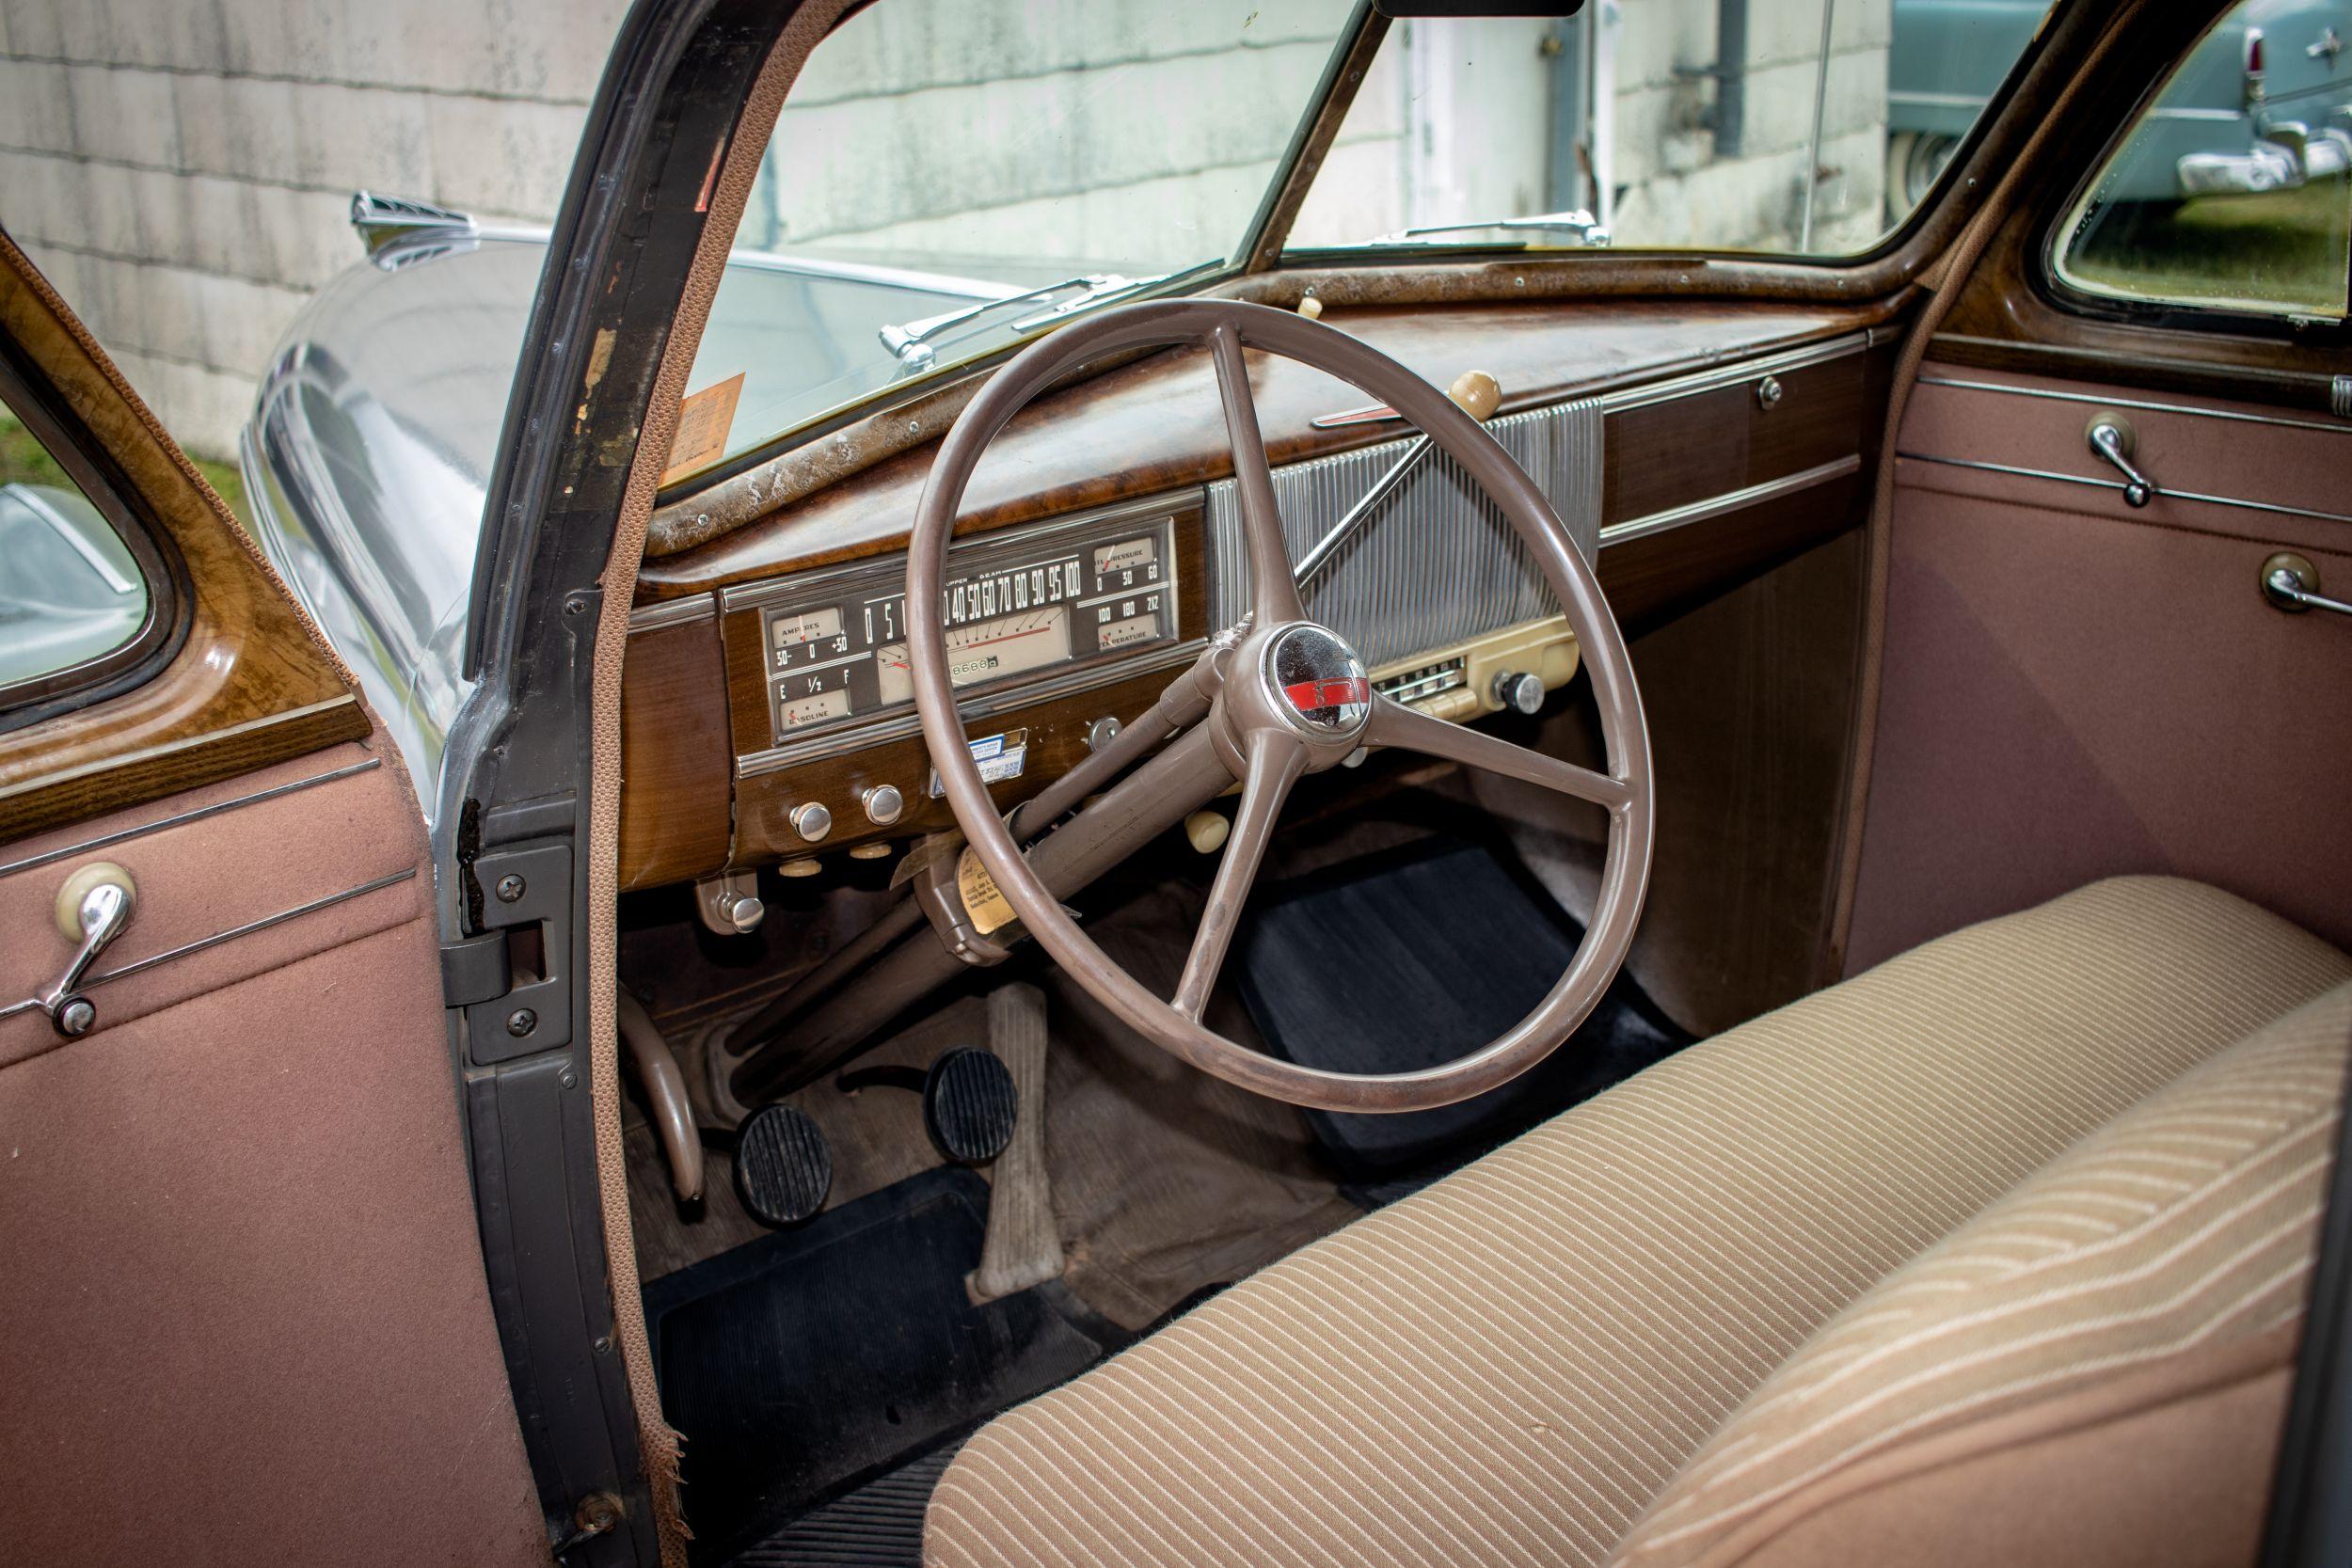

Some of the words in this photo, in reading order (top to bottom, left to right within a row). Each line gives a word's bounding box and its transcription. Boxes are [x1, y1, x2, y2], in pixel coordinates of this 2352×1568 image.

[946, 578, 968, 587] UPPER
[979, 570, 1002, 579] BEAM
[1096, 577, 1103, 592] 0
[1122, 570, 1133, 586] 30
[1148, 564, 1158, 580] 60
[865, 608, 873, 644] 0
[884, 602, 894, 640] 5
[952, 586, 966, 624] 40
[967, 583, 981, 621] 50
[981, 579, 996, 617] 60
[997, 576, 1012, 613] 70
[1014, 572, 1028, 610] 80
[1031, 568, 1045, 606] 90
[1048, 564, 1062, 602] 95
[1064, 561, 1081, 598] 100
[1098, 607, 1111, 624] 100
[1122, 600, 1136, 618] 180
[1147, 594, 1159, 611] 212
[782, 622, 819, 636] AMPRES
[1099, 631, 1147, 647] EPERATURE
[808, 643, 816, 659] 0
[779, 684, 787, 700] E
[843, 669, 850, 685] F
